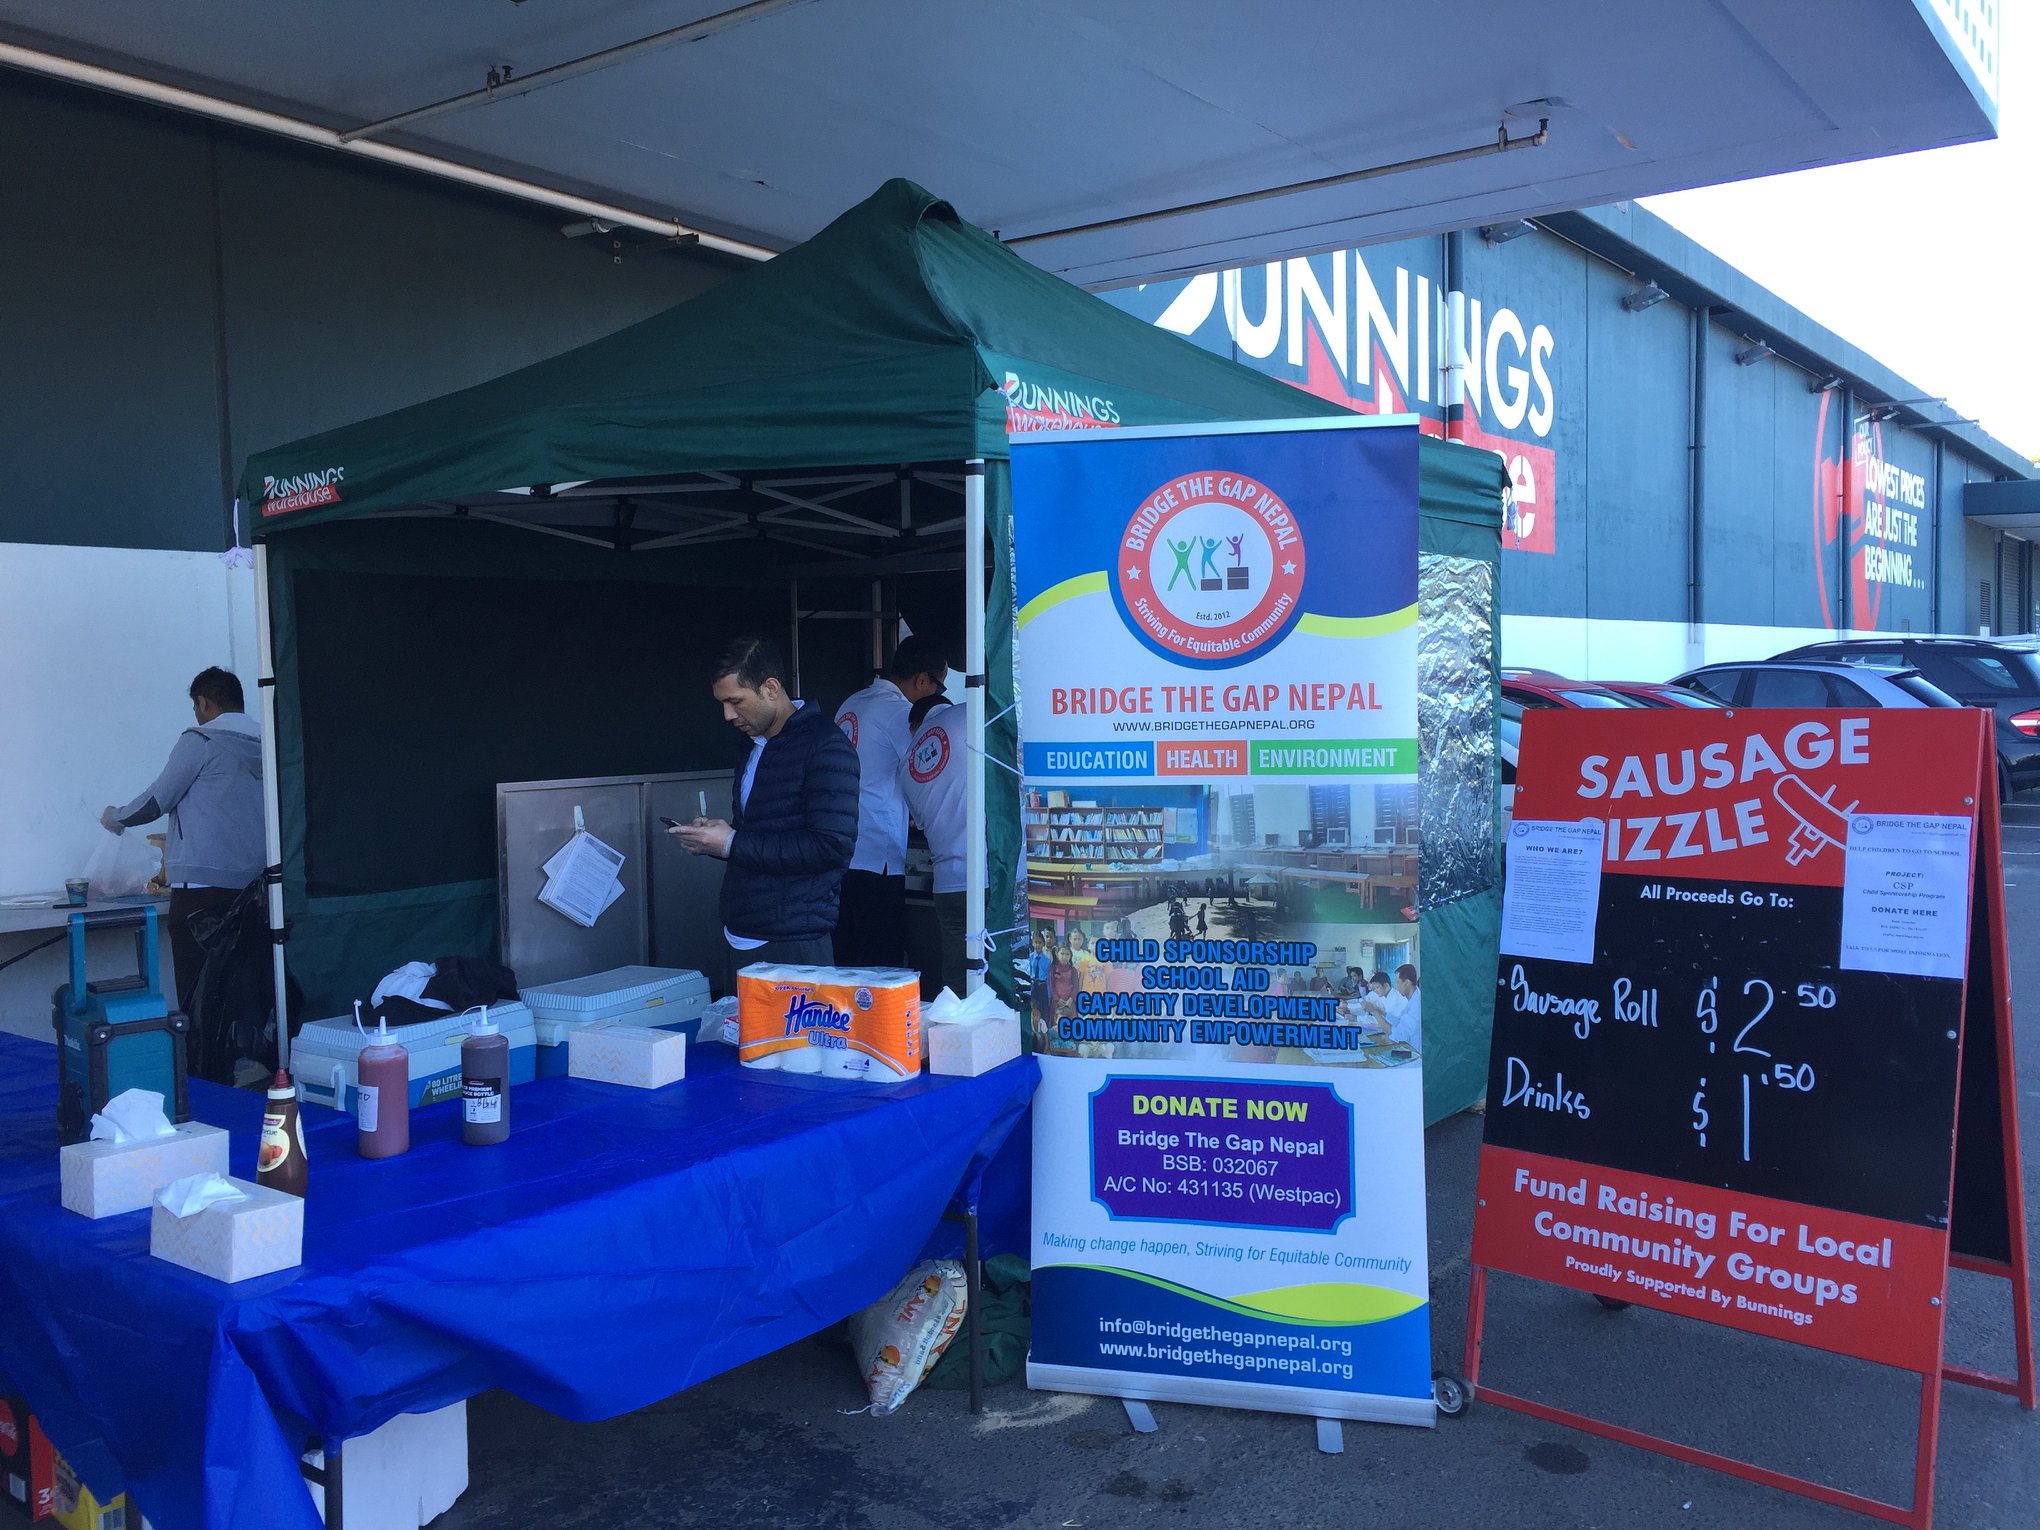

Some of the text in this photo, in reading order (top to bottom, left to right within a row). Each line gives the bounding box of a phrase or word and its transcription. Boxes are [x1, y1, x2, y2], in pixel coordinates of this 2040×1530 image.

[1005, 371, 1121, 424] BUNNINGS
[1865, 455, 1925, 510] LOWEST PRICES
[1125, 476, 1298, 552] BRIDGE THE GAP NEPAL
[1864, 500, 1918, 547] ARE JUST THE
[1134, 592, 1293, 654] Striving For Equitable Community
[1195, 610, 1231, 621] Estd. 2012
[1051, 682, 1383, 715] BRIDGE THE GAP NEPAL
[1113, 719, 1315, 732] WWW.BRIDGETHEGAPNEPAL.ORG
[1046, 747, 1398, 770] EDUCATION HEALTH ENVIRONMENT
[1576, 717, 1870, 799] SAUSAGE
[1579, 797, 1770, 862] IZZLE
[1876, 820, 1904, 828] BRIDGE
[1561, 847, 1583, 855] ARE?
[1640, 884, 1795, 908] All Proceeds Go To:
[1893, 882, 1914, 890] CSP
[1871, 906, 1938, 917] DONATE HERE
[1095, 938, 1318, 967] CHILD SPONSORSHIP
[1142, 965, 1270, 992] SCHOOL AID
[784, 993, 852, 1037] Handee
[1076, 991, 1340, 1022] CAPACITY DEVELOPMENT
[1510, 963, 1602, 1039] Sausage
[1613, 977, 1659, 1028] Roll
[808, 1030, 848, 1050] Ultra
[1057, 1017, 1361, 1051] COMMUNITY EMPOWERMENT
[1502, 1056, 1591, 1120] Drinks
[1133, 1095, 1308, 1122] DONATE NOW
[1117, 1129, 1325, 1158] Bridge The Gap Nepal
[1163, 1155, 1279, 1177] BSB: 032067
[1103, 1176, 1342, 1209] A/C No: 431135 (Westpac)
[1514, 1168, 1892, 1269] Fund Raising For Local
[1042, 1231, 1412, 1274] Making change happen, Striving for Equitable Community
[1534, 1210, 1858, 1306] Community Groups
[1565, 1255, 1814, 1326] Proudly Supported By Bunnings
[1099, 1317, 1353, 1356] info@bridgethegapnepal.org
[1099, 1341, 1354, 1379] www.bridgethegapnepal.org
